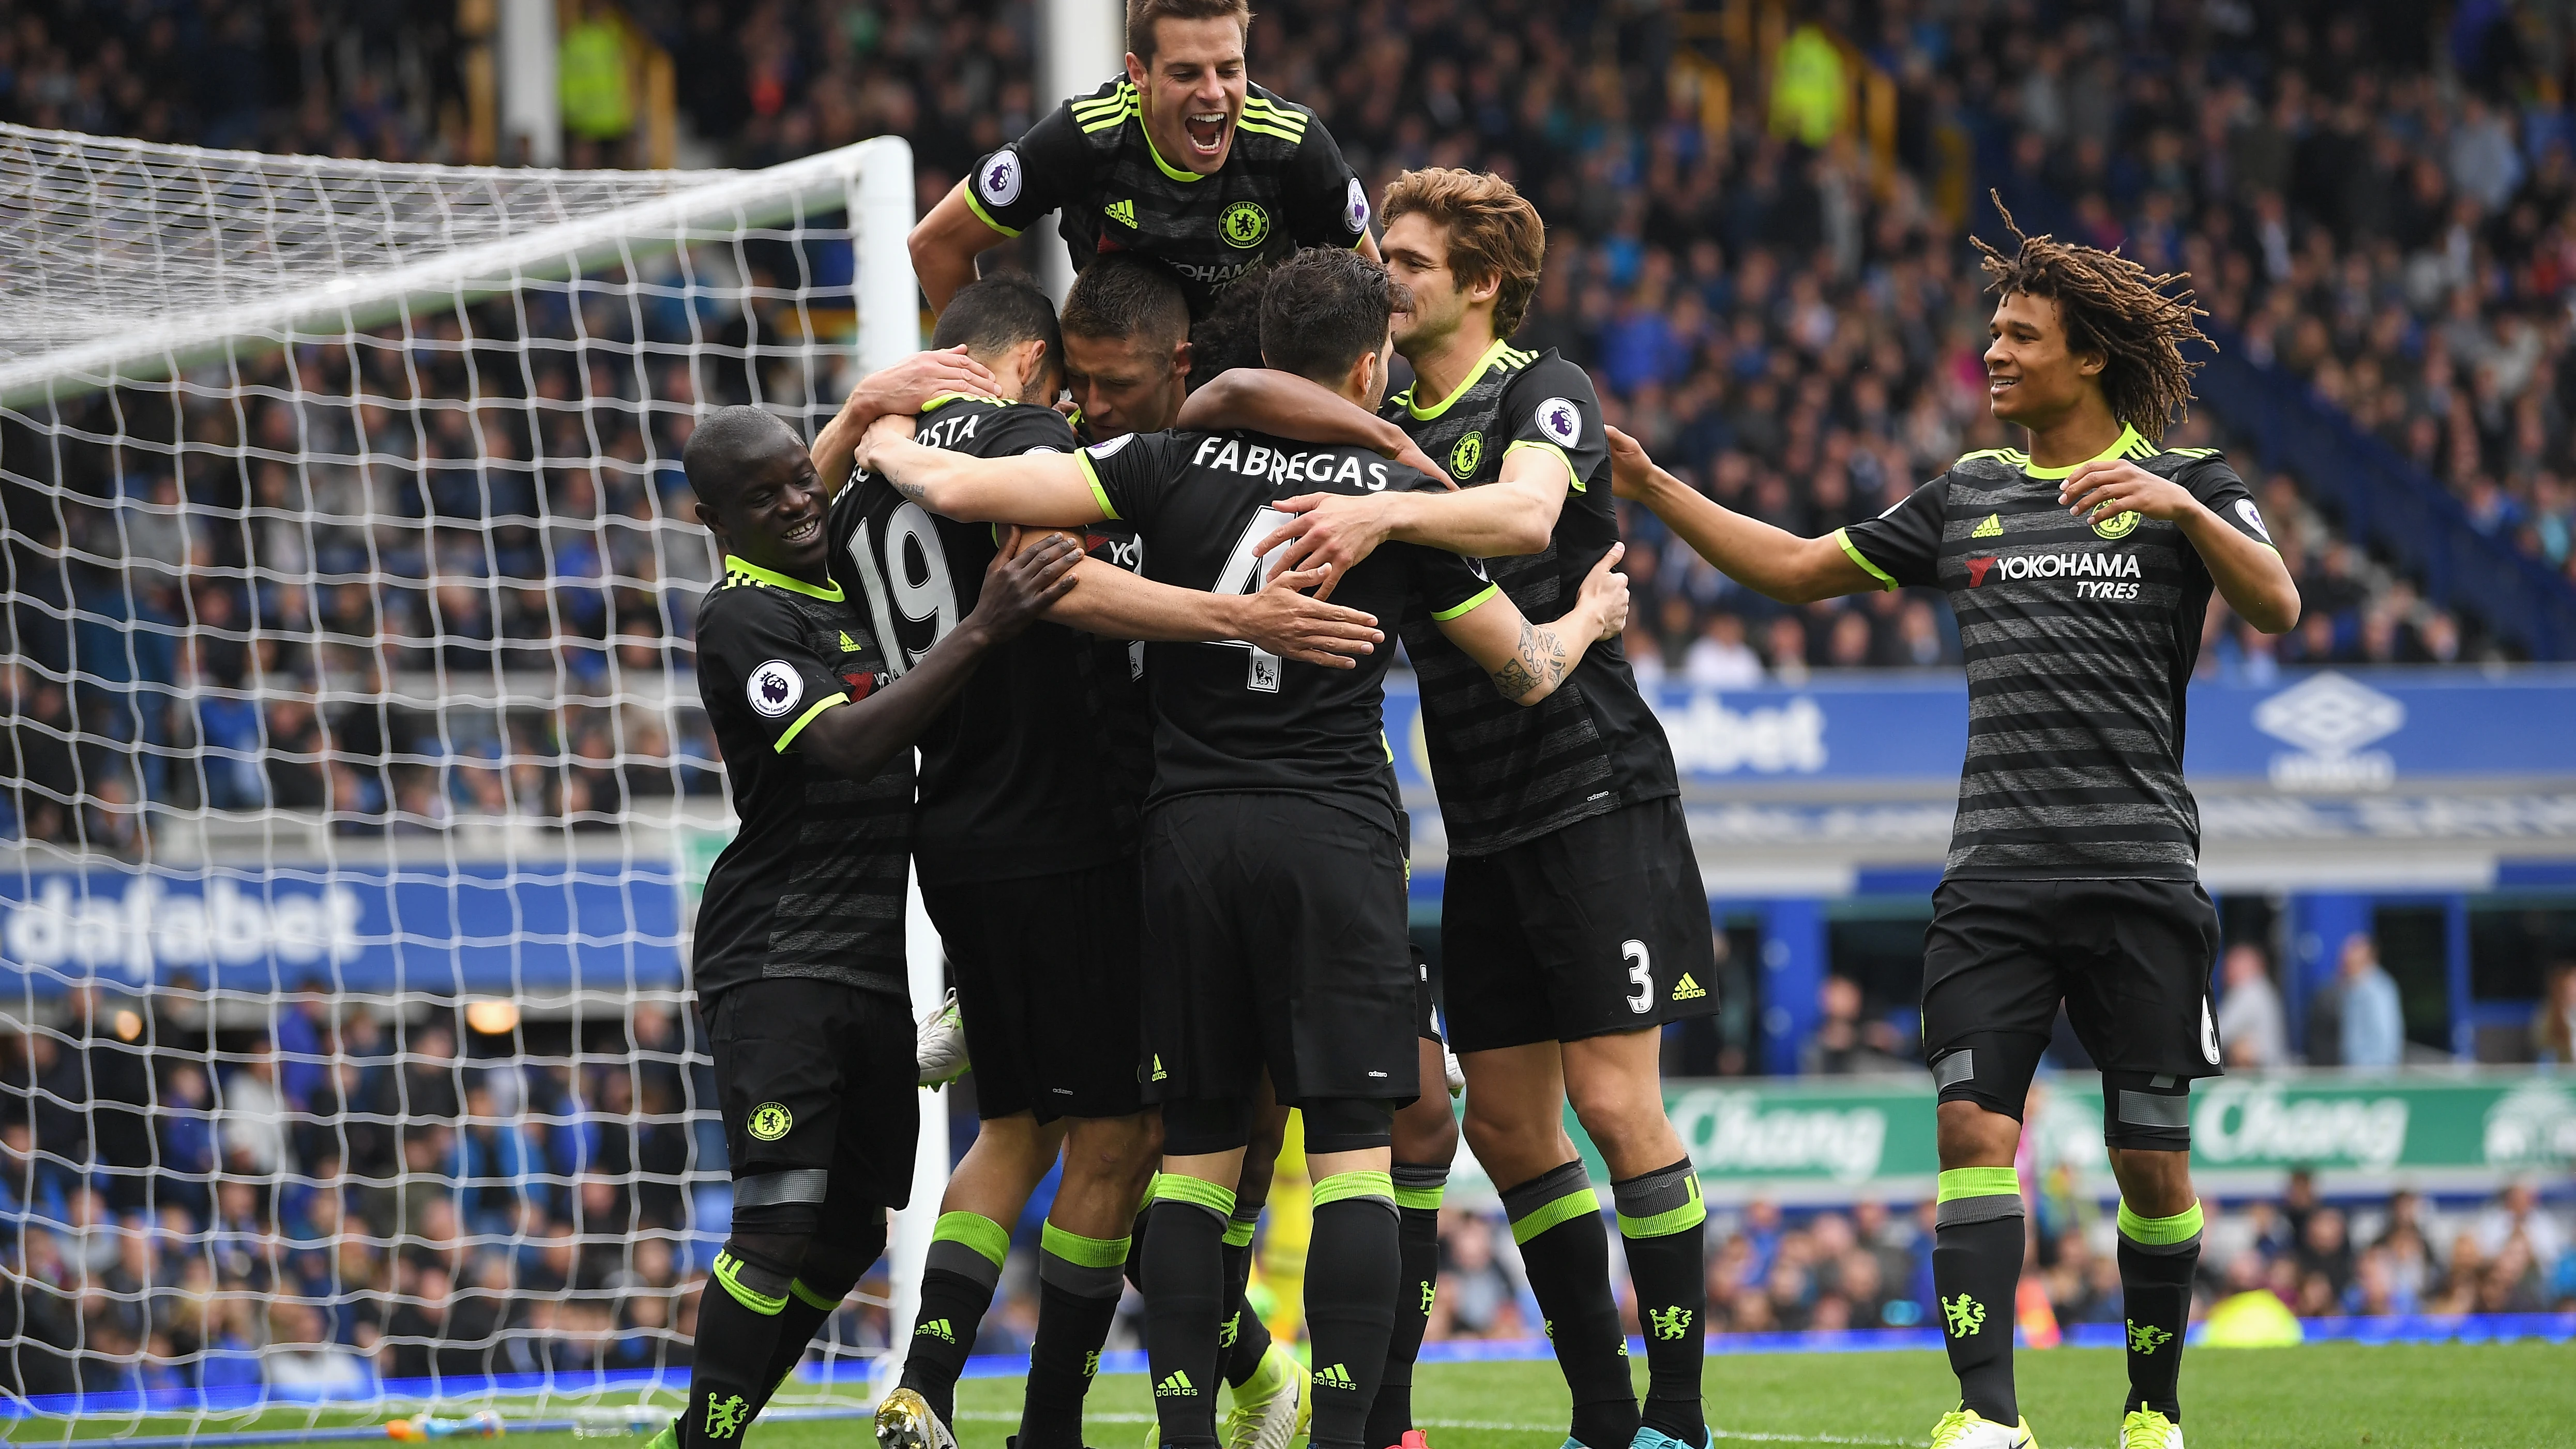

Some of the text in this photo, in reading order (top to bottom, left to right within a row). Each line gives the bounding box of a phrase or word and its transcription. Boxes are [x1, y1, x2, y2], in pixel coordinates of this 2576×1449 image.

[1104, 206, 1138, 229] adidas
[1227, 204, 1259, 214] CHELSEA
[914, 415, 979, 448] OSTA
[1460, 433, 1481, 446] CHELSEA
[1971, 526, 2004, 538] adidas
[1997, 553, 2142, 581] YOKOHAMA
[846, 499, 959, 682] 19
[2076, 581, 2140, 600] TYRES
[1587, 791, 1609, 802] adizero
[6, 874, 361, 977] dafabet
[1622, 939, 1654, 1014] 3
[1672, 988, 1706, 1001] adidas
[757, 1104, 784, 1113] CHELSEA
[1670, 1088, 1886, 1184] Chang
[2193, 1082, 2408, 1174] Chang
[915, 1327, 956, 1345] adidas
[1156, 1386, 1198, 1397] adidas
[1312, 1376, 1357, 1391] adidas
